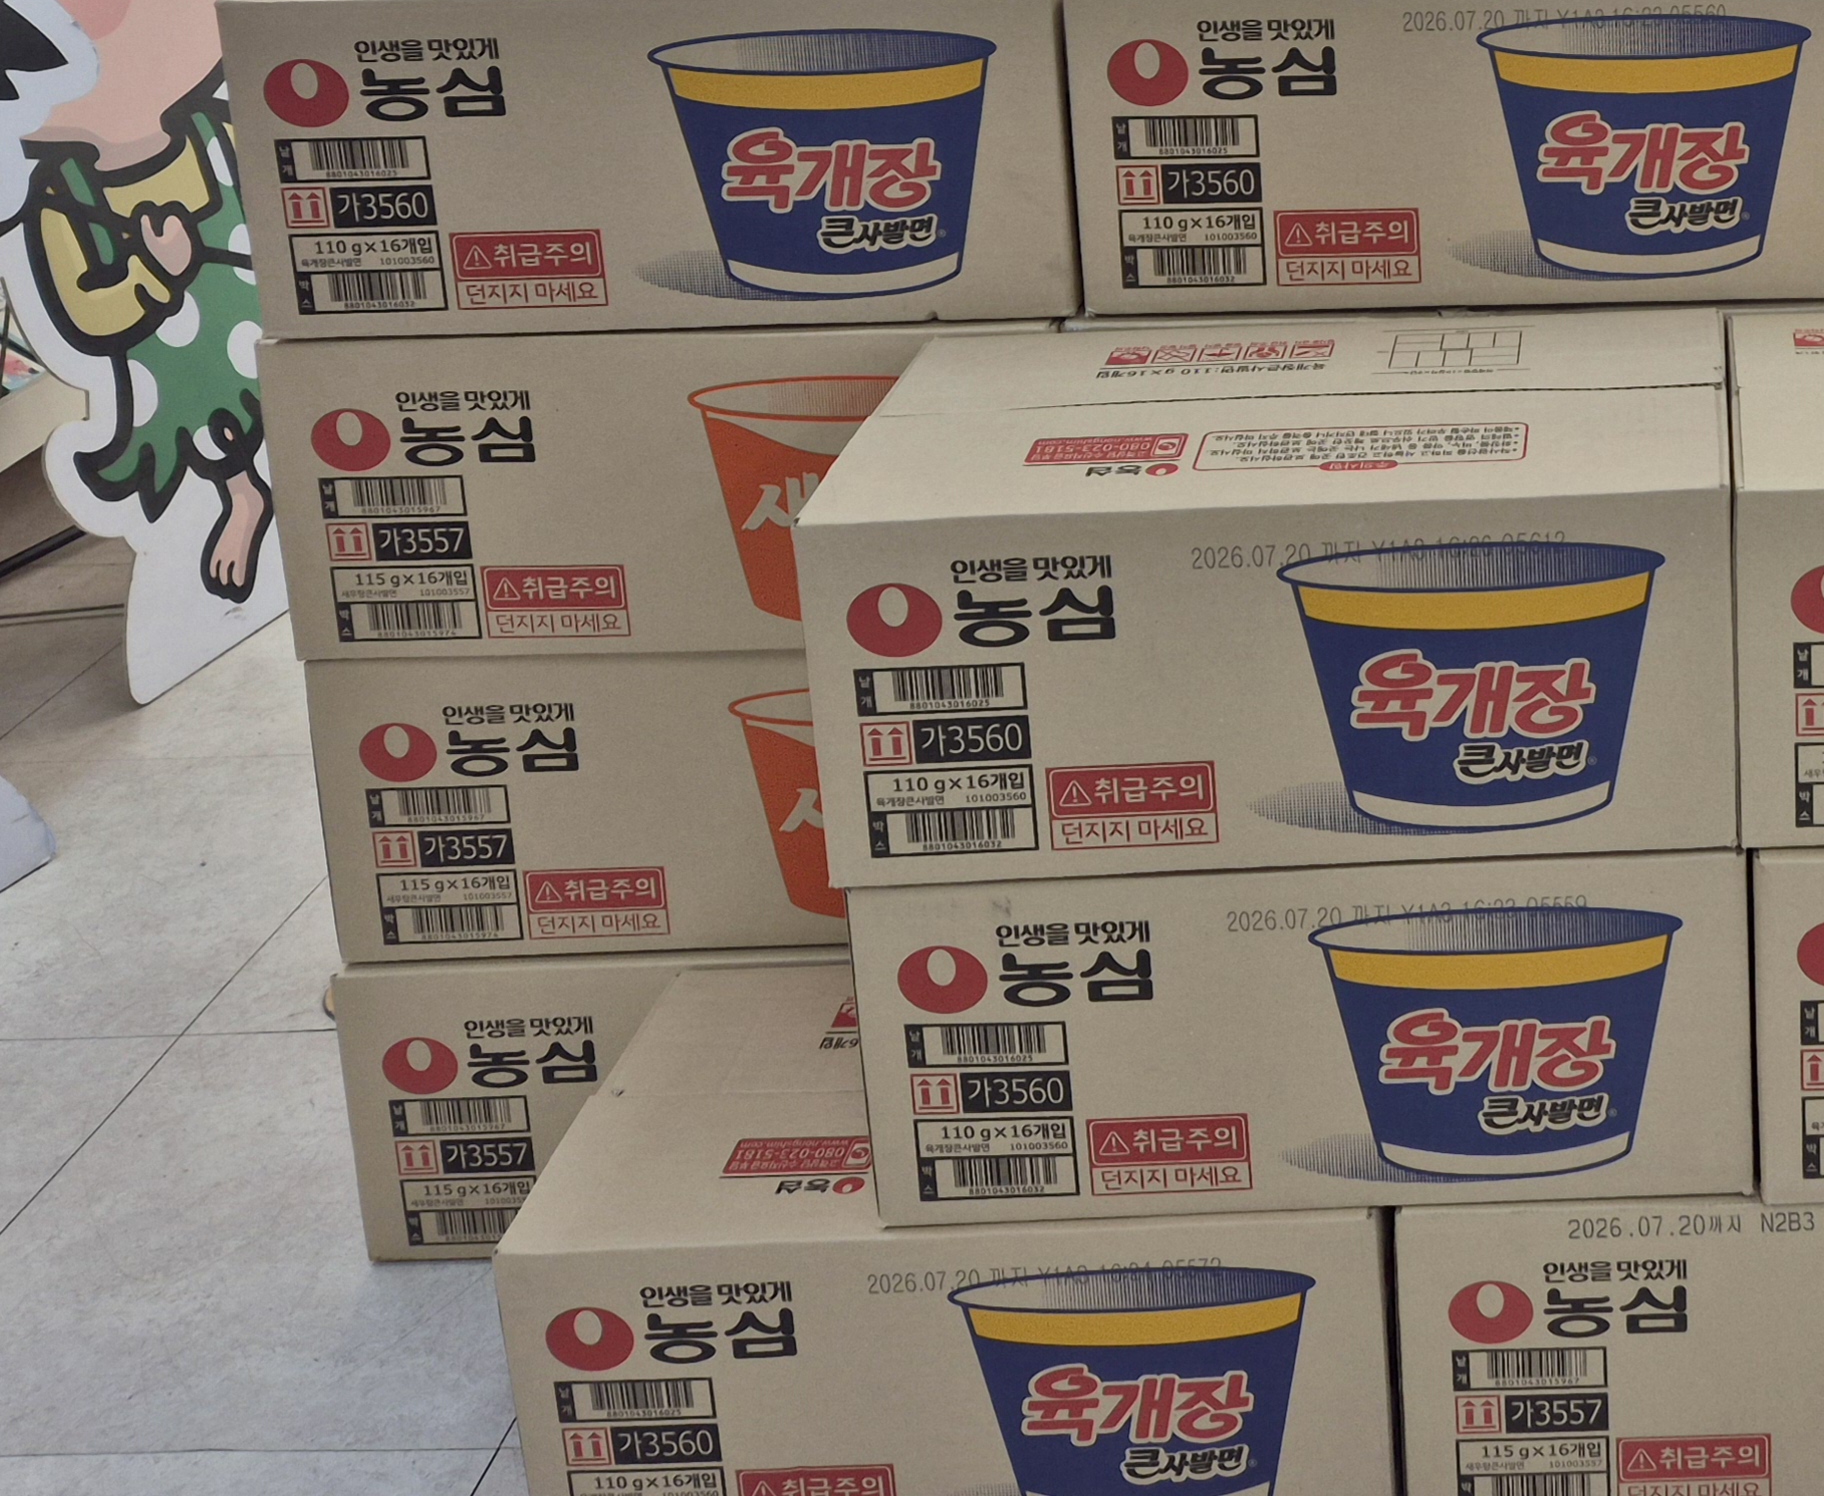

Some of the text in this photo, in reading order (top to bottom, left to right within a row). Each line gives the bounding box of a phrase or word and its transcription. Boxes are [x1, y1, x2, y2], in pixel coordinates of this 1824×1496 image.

[1198, 44, 1338, 102] 농심
[358, 65, 508, 122] 농심
[1535, 110, 1751, 195] 육개장
[713, 128, 947, 212] 육개장
[1167, 167, 1256, 199] 가3560
[336, 191, 430, 222] 가3560
[1313, 220, 1409, 247] 취급주의
[492, 243, 593, 269] 취급주의
[397, 415, 538, 468] 농심
[1036, 441, 1150, 453] 080-023-5181
[1085, 464, 1142, 476] 농심
[378, 528, 466, 556] 가3557
[520, 575, 617, 599] 취급주의
[952, 585, 1118, 648] 농심
[1346, 648, 1598, 740] 육개장
[444, 727, 581, 777] 농심
[920, 722, 1025, 757] 가3560
[1092, 776, 1204, 805] 취급주의
[424, 835, 510, 862] 가3557
[562, 877, 657, 901] 취급주의
[998, 949, 1155, 1007] 농심
[465, 1040, 599, 1089] 농심
[1374, 1007, 1619, 1093] 육개장
[967, 1076, 1066, 1108] 가3560
[736, 1147, 845, 1159] 080-023-5181
[1130, 1127, 1238, 1153] 취급주의
[446, 1143, 529, 1169] 가3557
[776, 1178, 830, 1194] 농심
[1760, 1212, 1816, 1233] N2B3
[1543, 1285, 1689, 1338] 농심
[643, 1308, 799, 1364] 농심
[1015, 1362, 1259, 1444] 육개장
[1511, 1399, 1603, 1428] 가3557
[617, 1429, 716, 1459] 가3560
[1659, 1445, 1760, 1469] 취급주의
[779, 1477, 885, 1495] 취급주의
